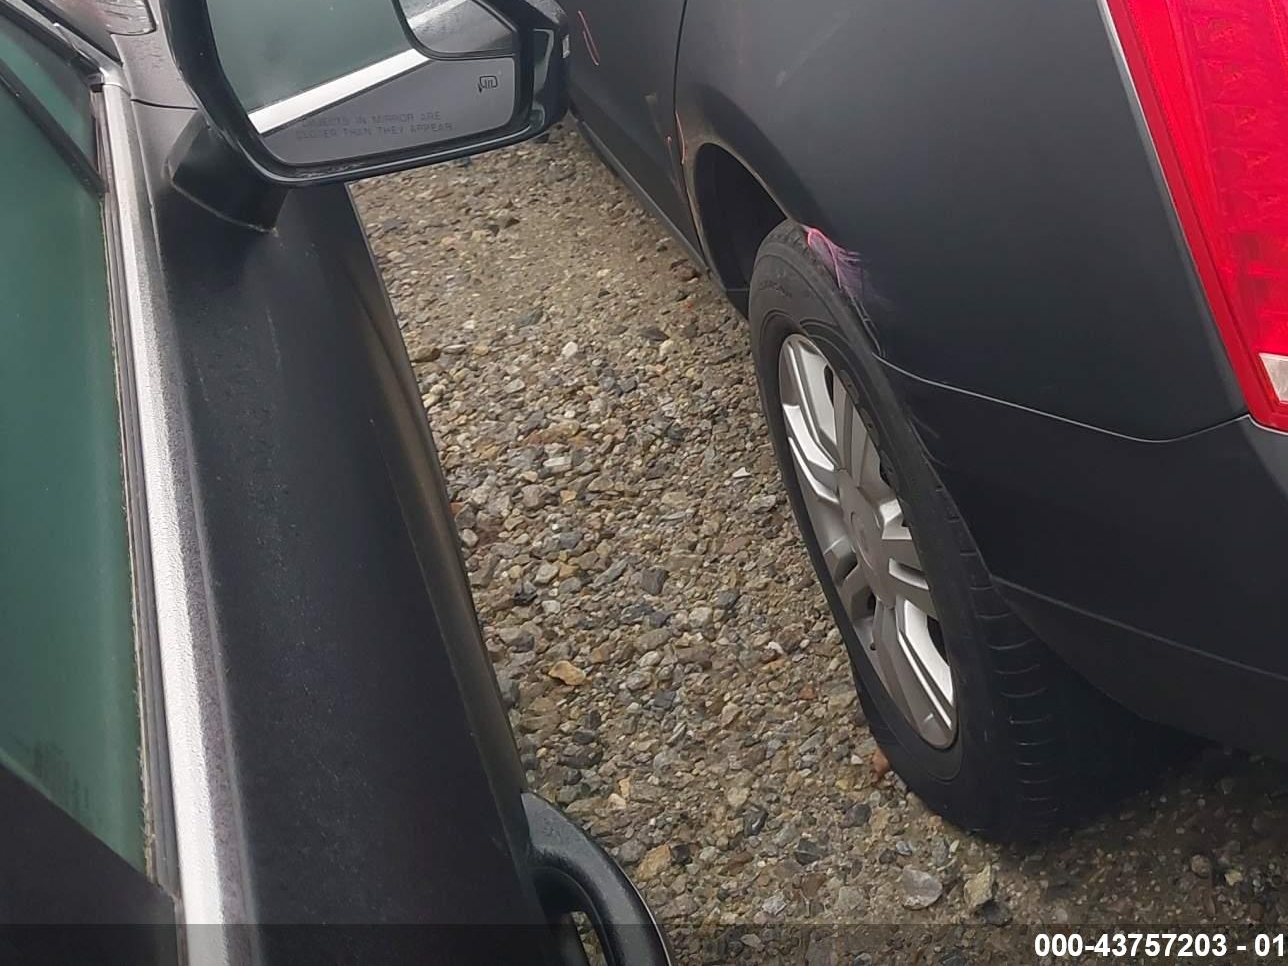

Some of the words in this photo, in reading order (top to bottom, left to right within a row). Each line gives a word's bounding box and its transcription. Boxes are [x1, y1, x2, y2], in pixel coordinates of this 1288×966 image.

[357, 115, 367, 125] IN
[372, 113, 413, 124] MIRROR
[420, 111, 441, 121] ARE
[343, 126, 372, 137] THAN
[377, 125, 403, 135] THEY
